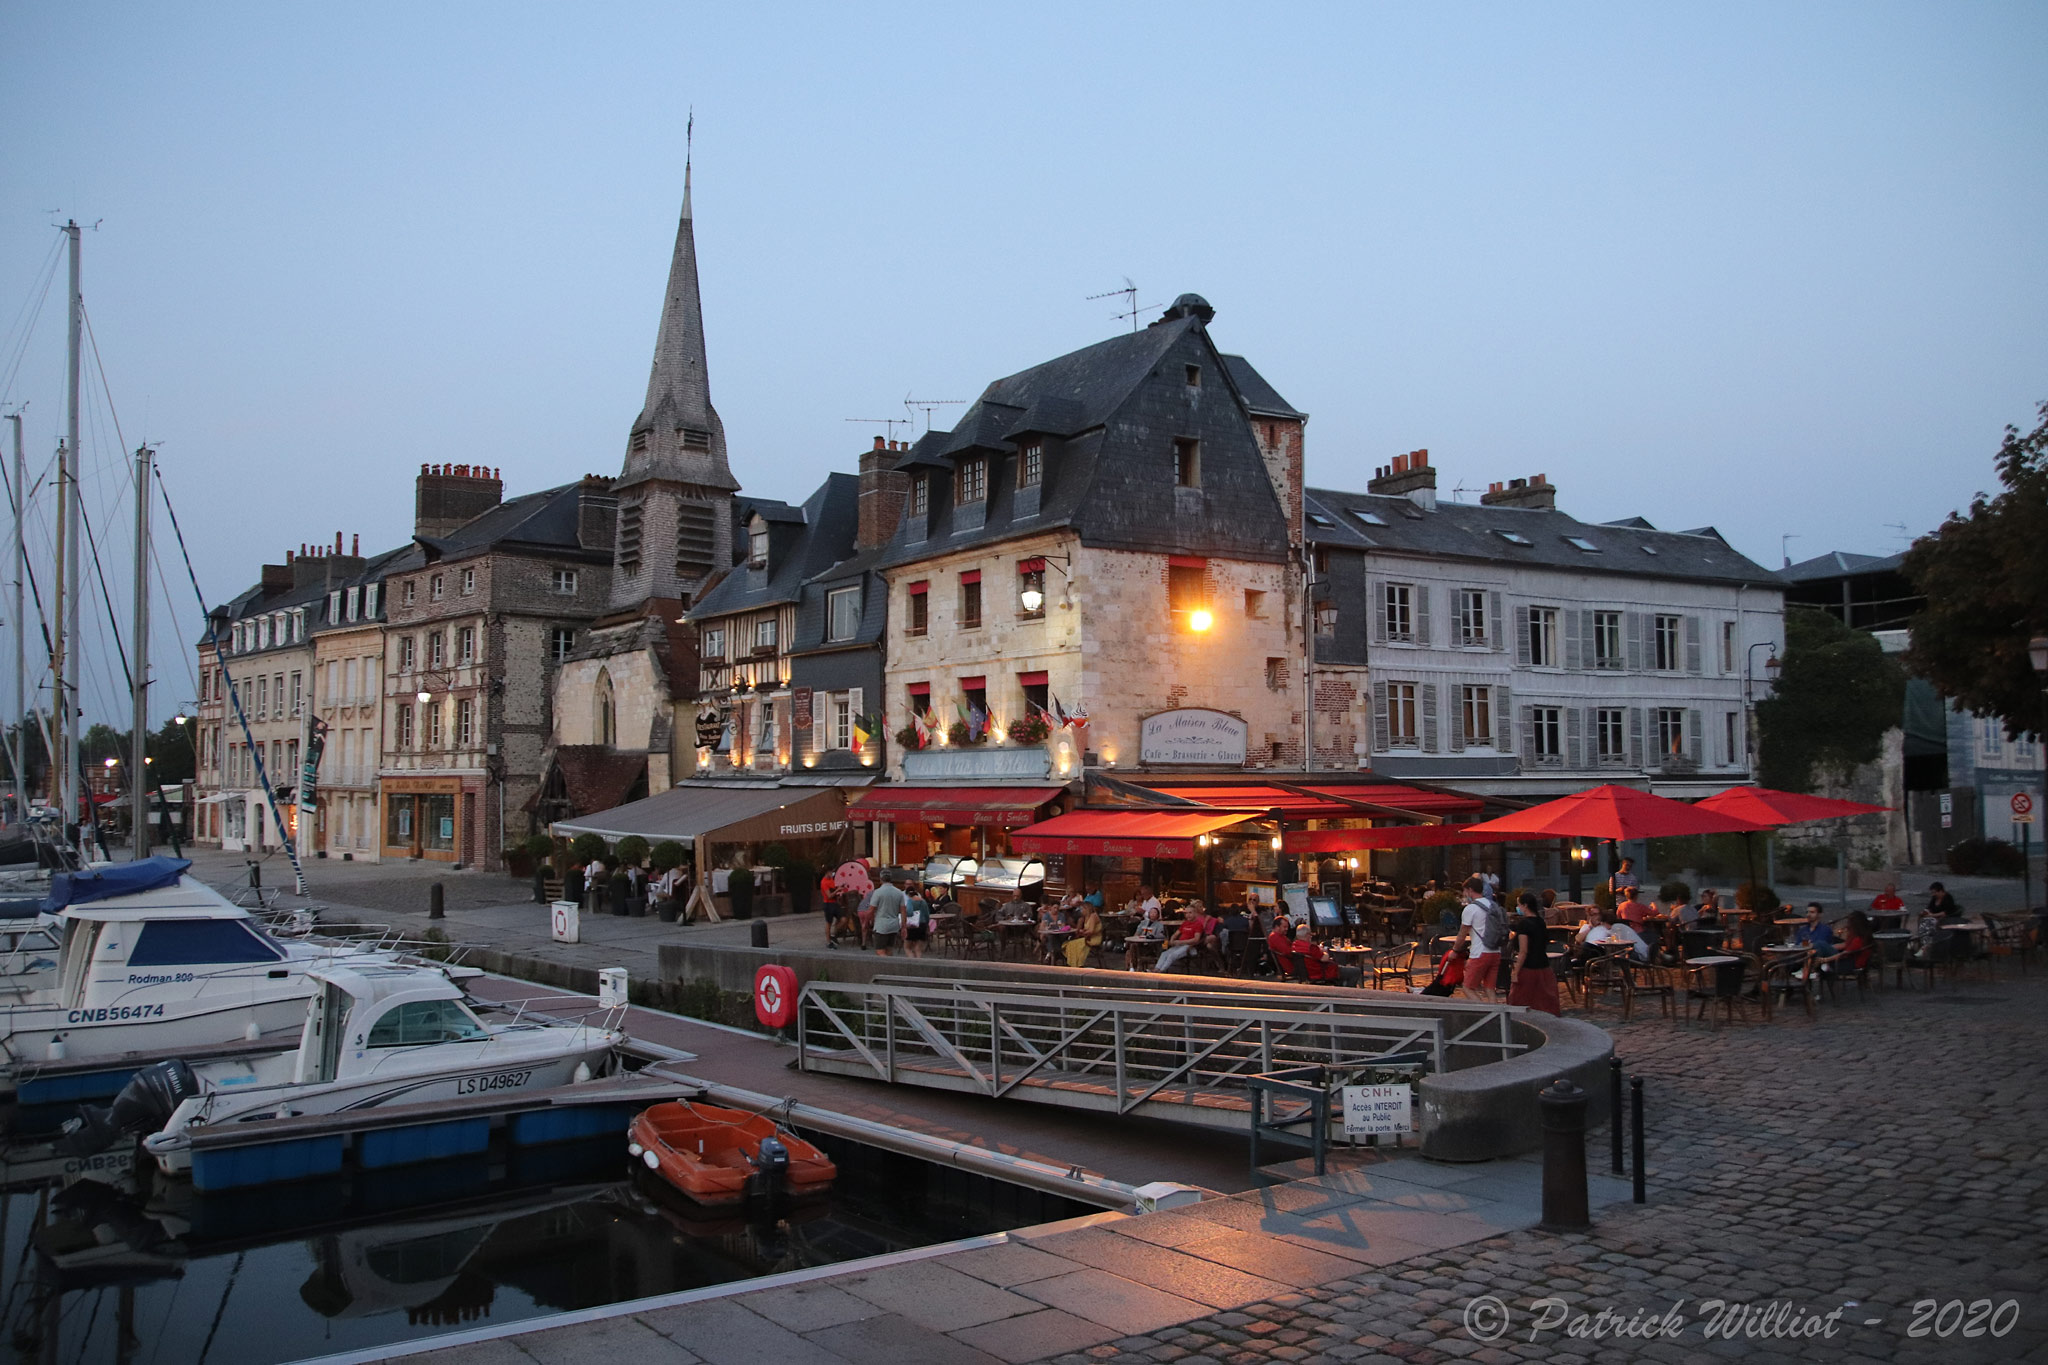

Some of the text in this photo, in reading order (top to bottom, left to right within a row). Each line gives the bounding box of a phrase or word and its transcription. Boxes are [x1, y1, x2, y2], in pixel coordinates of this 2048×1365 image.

[1148, 714, 1240, 737] La Maison Bleue
[1172, 749, 1207, 760] Brasserie
[1217, 750, 1242, 761] Glaces
[996, 813, 1003, 822] &
[1006, 812, 1030, 823] Sorbets
[780, 824, 813, 835] FRUITS
[814, 822, 827, 832] DE
[128, 973, 194, 984] Rodman 800
[68, 1004, 164, 1023] CNB56474
[166, 1066, 183, 1095] YAMAHA
[457, 1072, 532, 1095] LS D49627
[1352, 1101, 1402, 1111] Accès INTERDIT
[1372, 1113, 1391, 1121] Public
[1394, 1123, 1409, 1131] Merci
